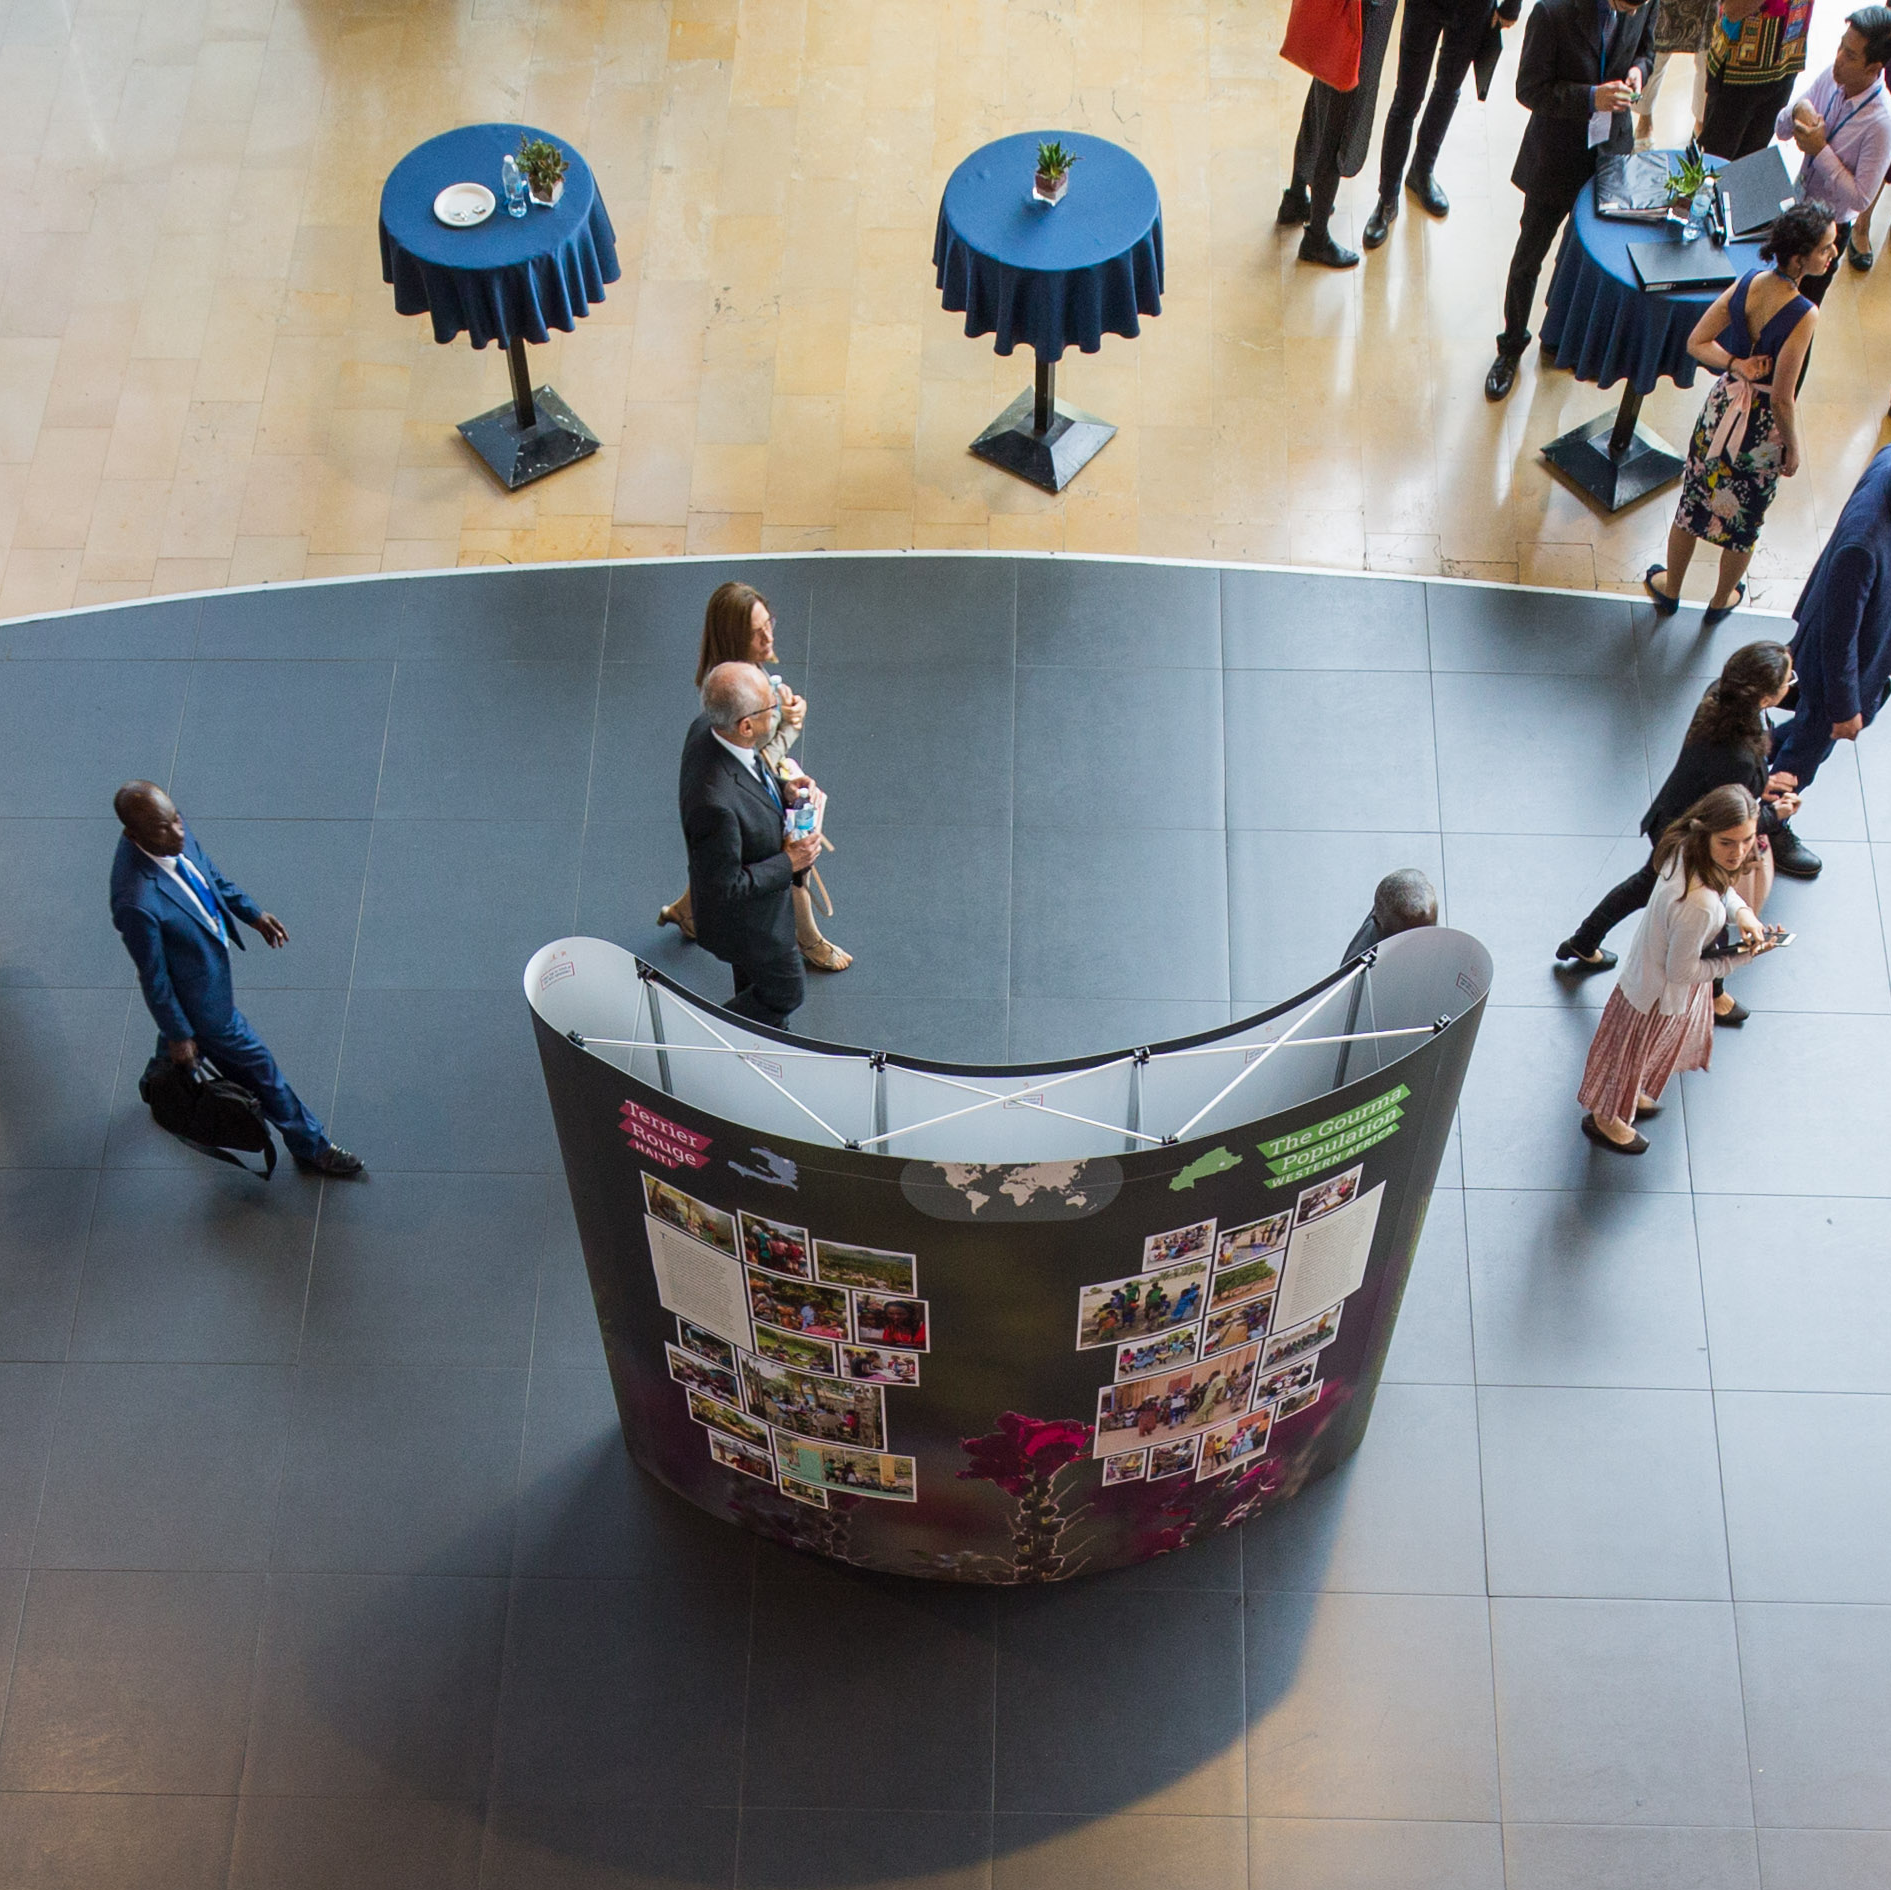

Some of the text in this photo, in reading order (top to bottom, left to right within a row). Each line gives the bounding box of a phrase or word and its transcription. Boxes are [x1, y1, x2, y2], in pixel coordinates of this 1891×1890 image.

[629, 1101, 698, 1148] Terrier
[632, 1122, 697, 1166] Rouge
[1270, 1087, 1402, 1155] The Gourma
[1281, 1109, 1397, 1171] Population
[635, 1141, 672, 1167] HAITI
[1272, 1124, 1394, 1187] WESTERN AFRICA
